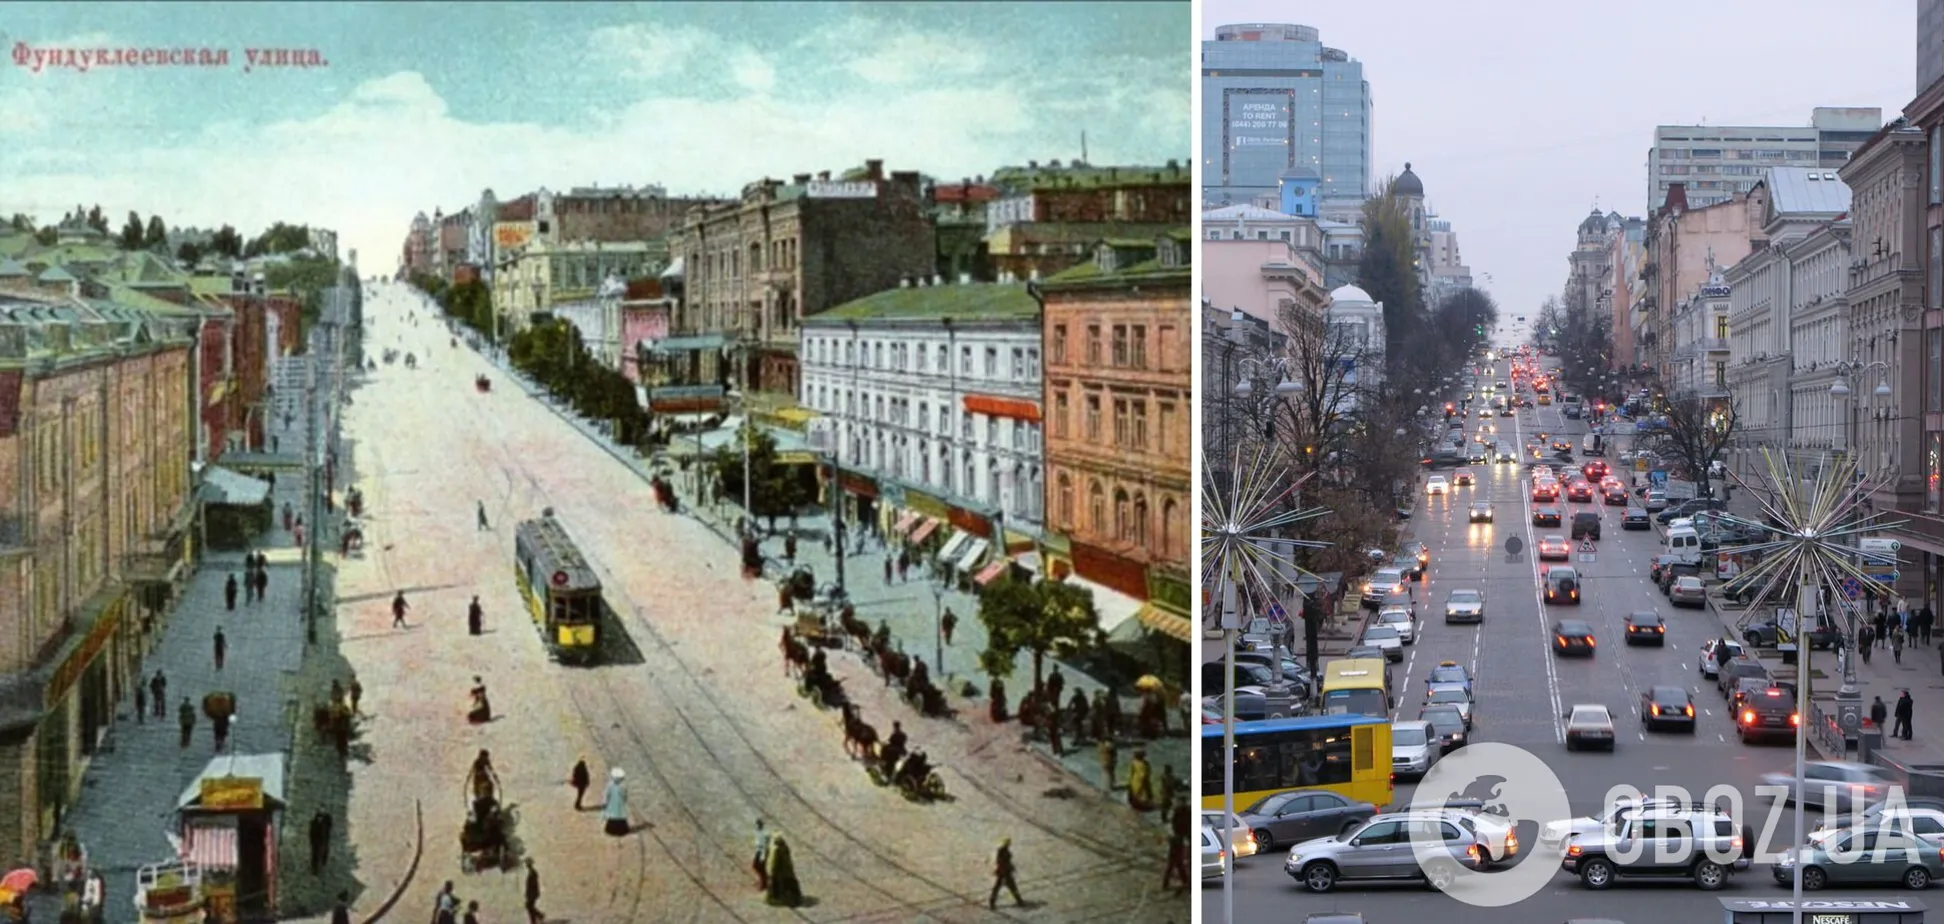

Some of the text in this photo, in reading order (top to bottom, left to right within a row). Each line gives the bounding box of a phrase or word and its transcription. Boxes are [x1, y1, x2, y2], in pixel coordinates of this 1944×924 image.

[1243, 103, 1276, 111] АРЕНДА
[1242, 112, 1276, 120] TO RENT
